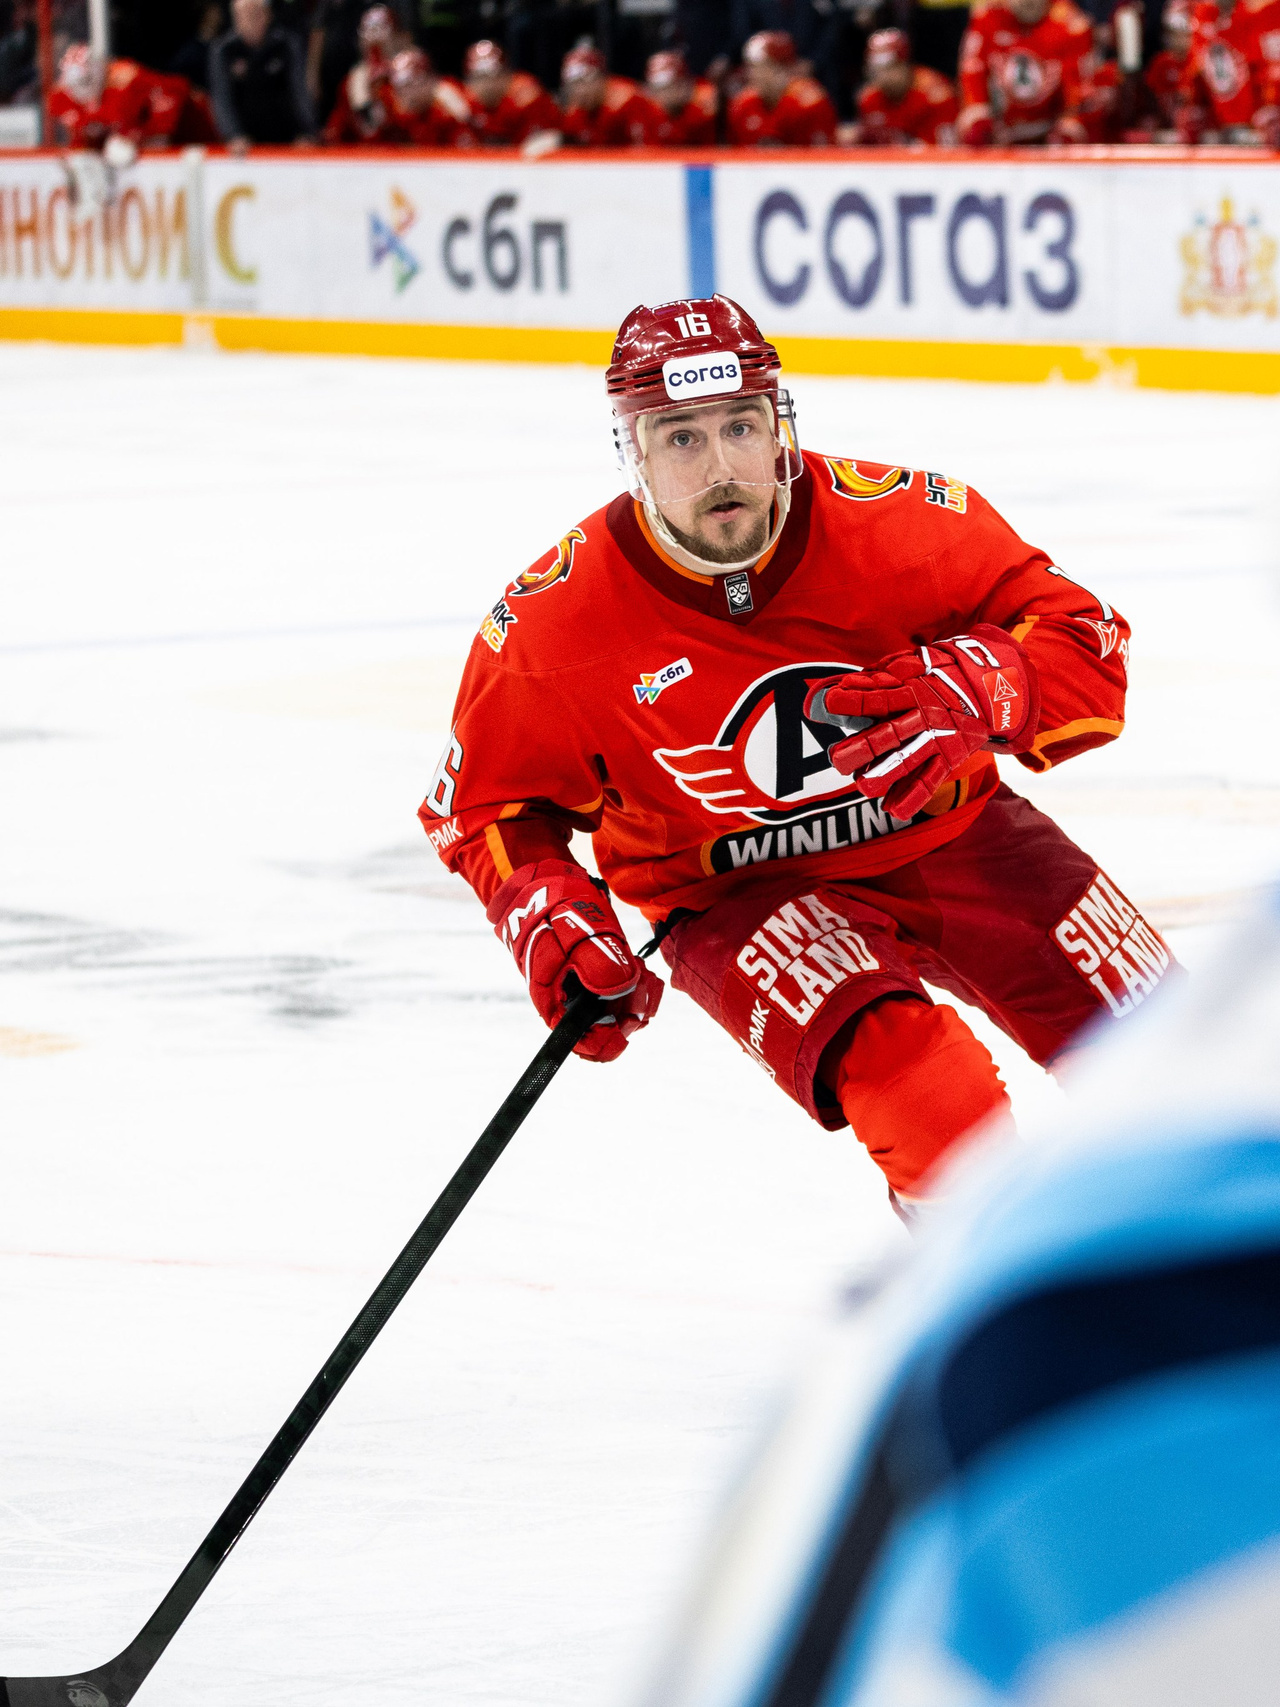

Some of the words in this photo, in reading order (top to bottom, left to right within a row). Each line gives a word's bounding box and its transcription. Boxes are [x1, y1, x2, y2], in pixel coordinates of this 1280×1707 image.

[441, 193, 570, 292] сбп
[753, 188, 1082, 313] согаз
[674, 313, 712, 338] 16
[668, 364, 738, 387] согаз
[660, 665, 685, 683] сбп
[426, 731, 463, 818] 6
[737, 894, 850, 991] SIMA
[1055, 872, 1137, 974] SIMA
[1088, 917, 1170, 1018] LAND
[768, 929, 879, 1026] LAND
